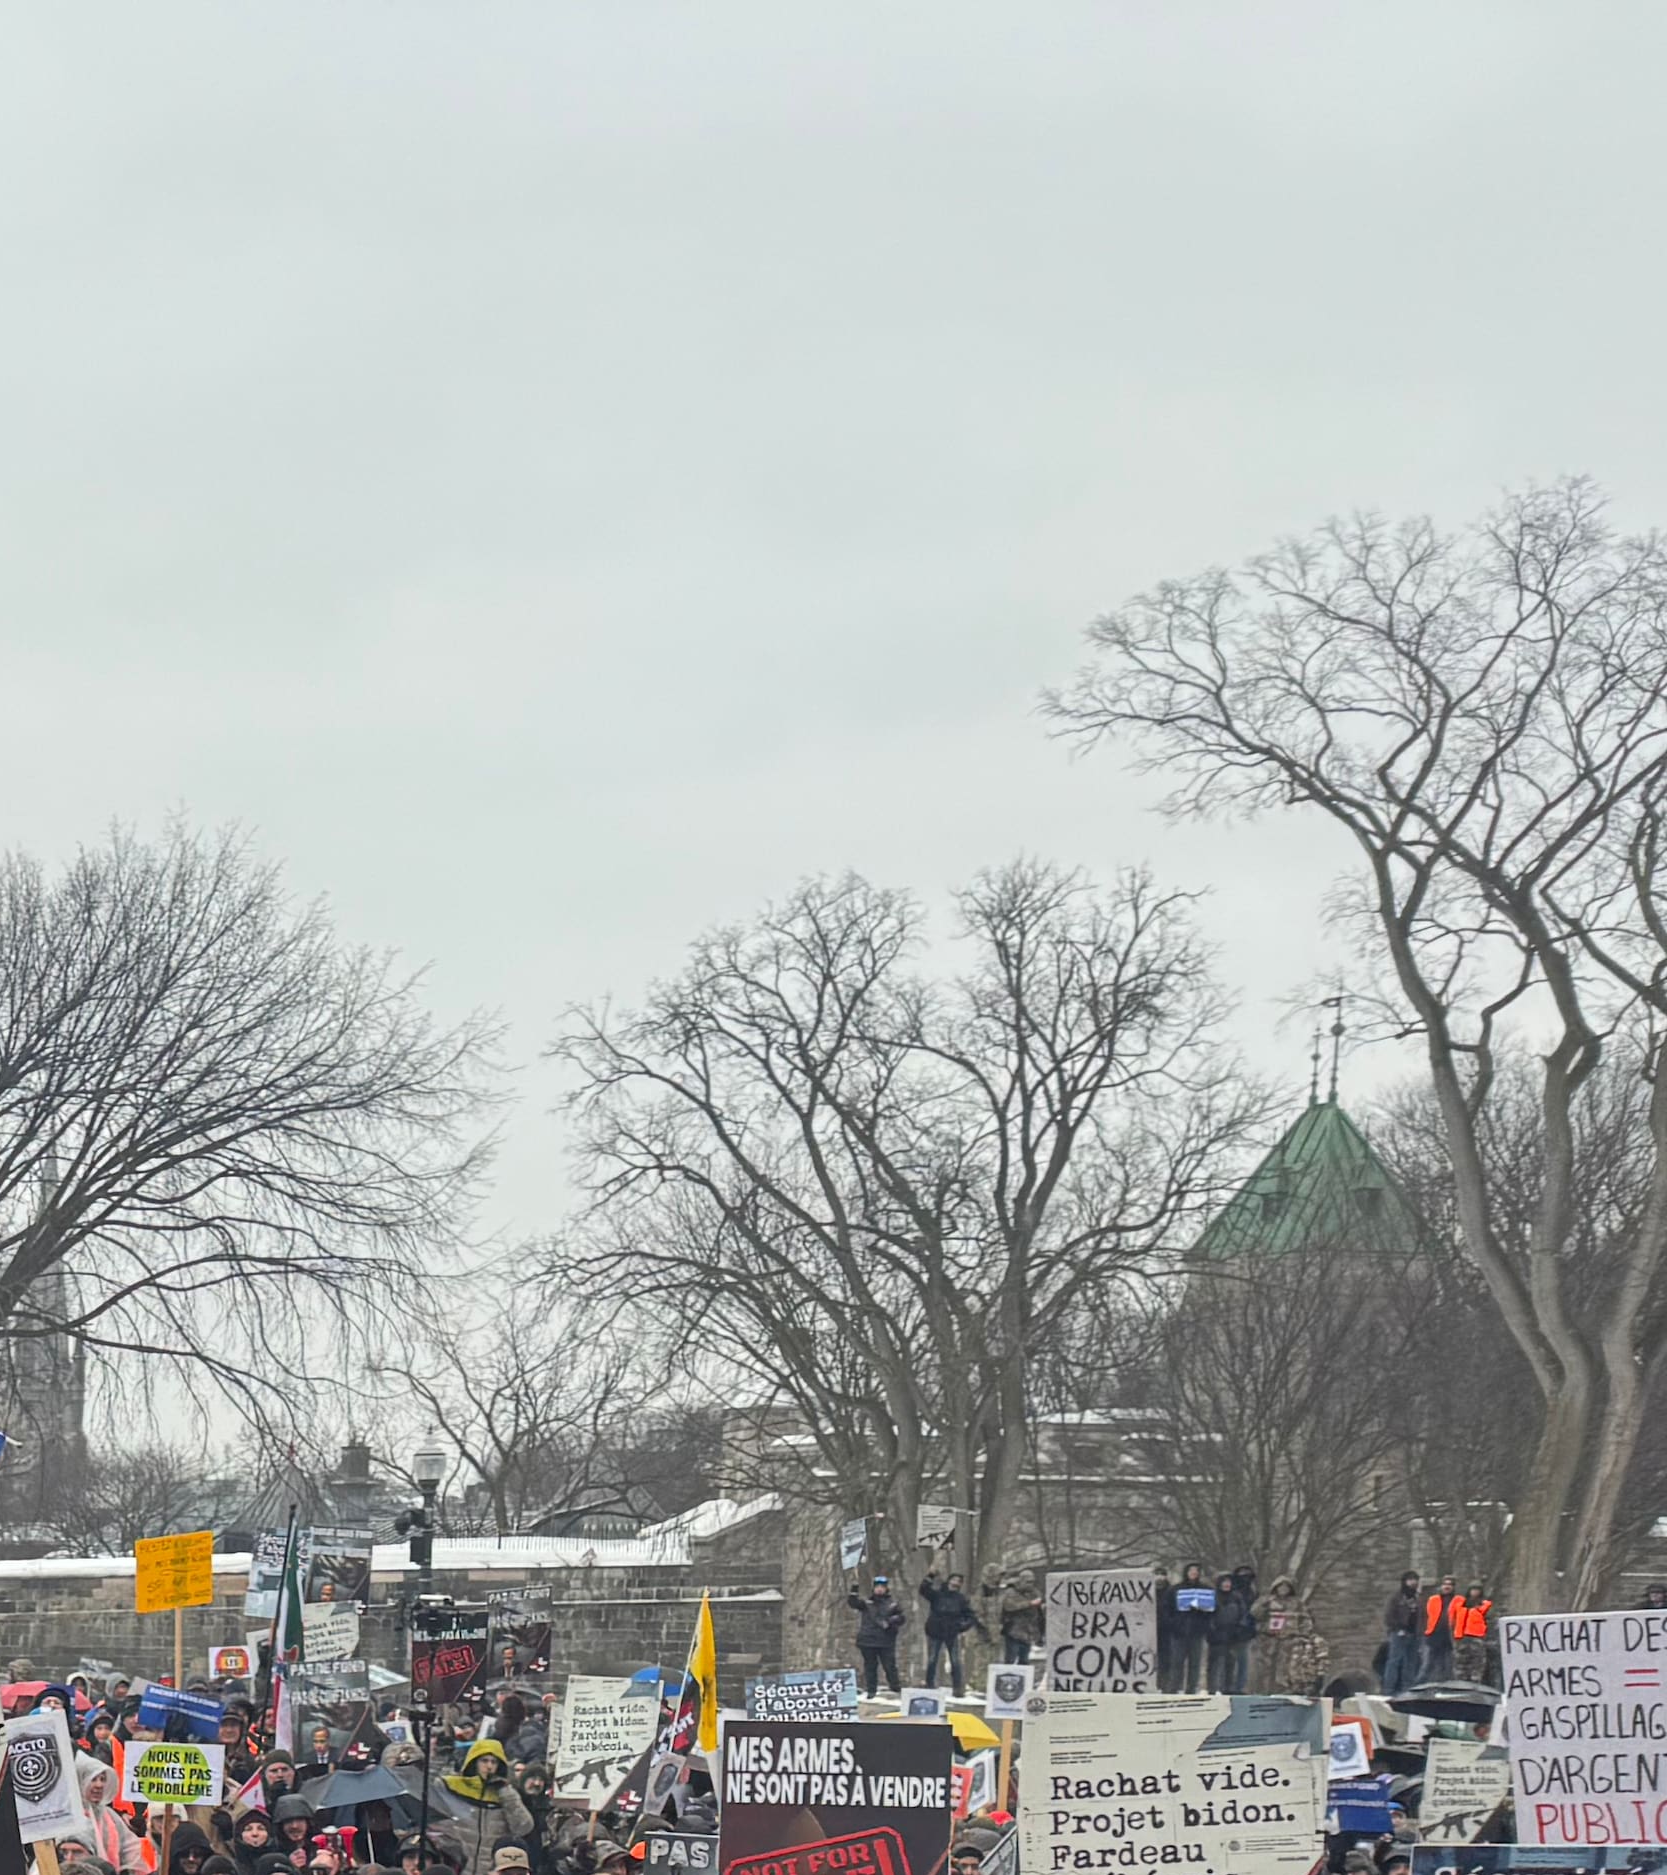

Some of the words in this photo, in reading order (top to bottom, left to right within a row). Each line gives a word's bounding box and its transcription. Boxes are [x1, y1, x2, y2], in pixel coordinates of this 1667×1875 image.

[1070, 1610, 1145, 1640] BRA-
[1504, 1618, 1607, 1655] RACHAT
[753, 1677, 845, 1699] Sécurité
[1507, 1665, 1603, 1699] ARMES
[754, 1694, 838, 1714] d'abord.
[147, 1750, 180, 1764] NOUS
[184, 1751, 200, 1765] NE
[727, 1735, 775, 1774] MES
[130, 1780, 144, 1793] LE
[133, 1765, 186, 1780] SOMMES
[189, 1768, 212, 1781] PAS
[1049, 1768, 1182, 1801] Rachat
[1196, 1763, 1292, 1792] vide.
[725, 1772, 753, 1805] NE
[753, 1773, 809, 1806] SONT
[809, 1774, 849, 1807] PAS
[869, 1775, 947, 1809] VENDRE
[1048, 1805, 1166, 1839] Projet
[1180, 1799, 1296, 1828] bidon.
[650, 1838, 710, 1869] PAS
[807, 1843, 872, 1873] FOR
[1049, 1840, 1207, 1871] Fardeau
